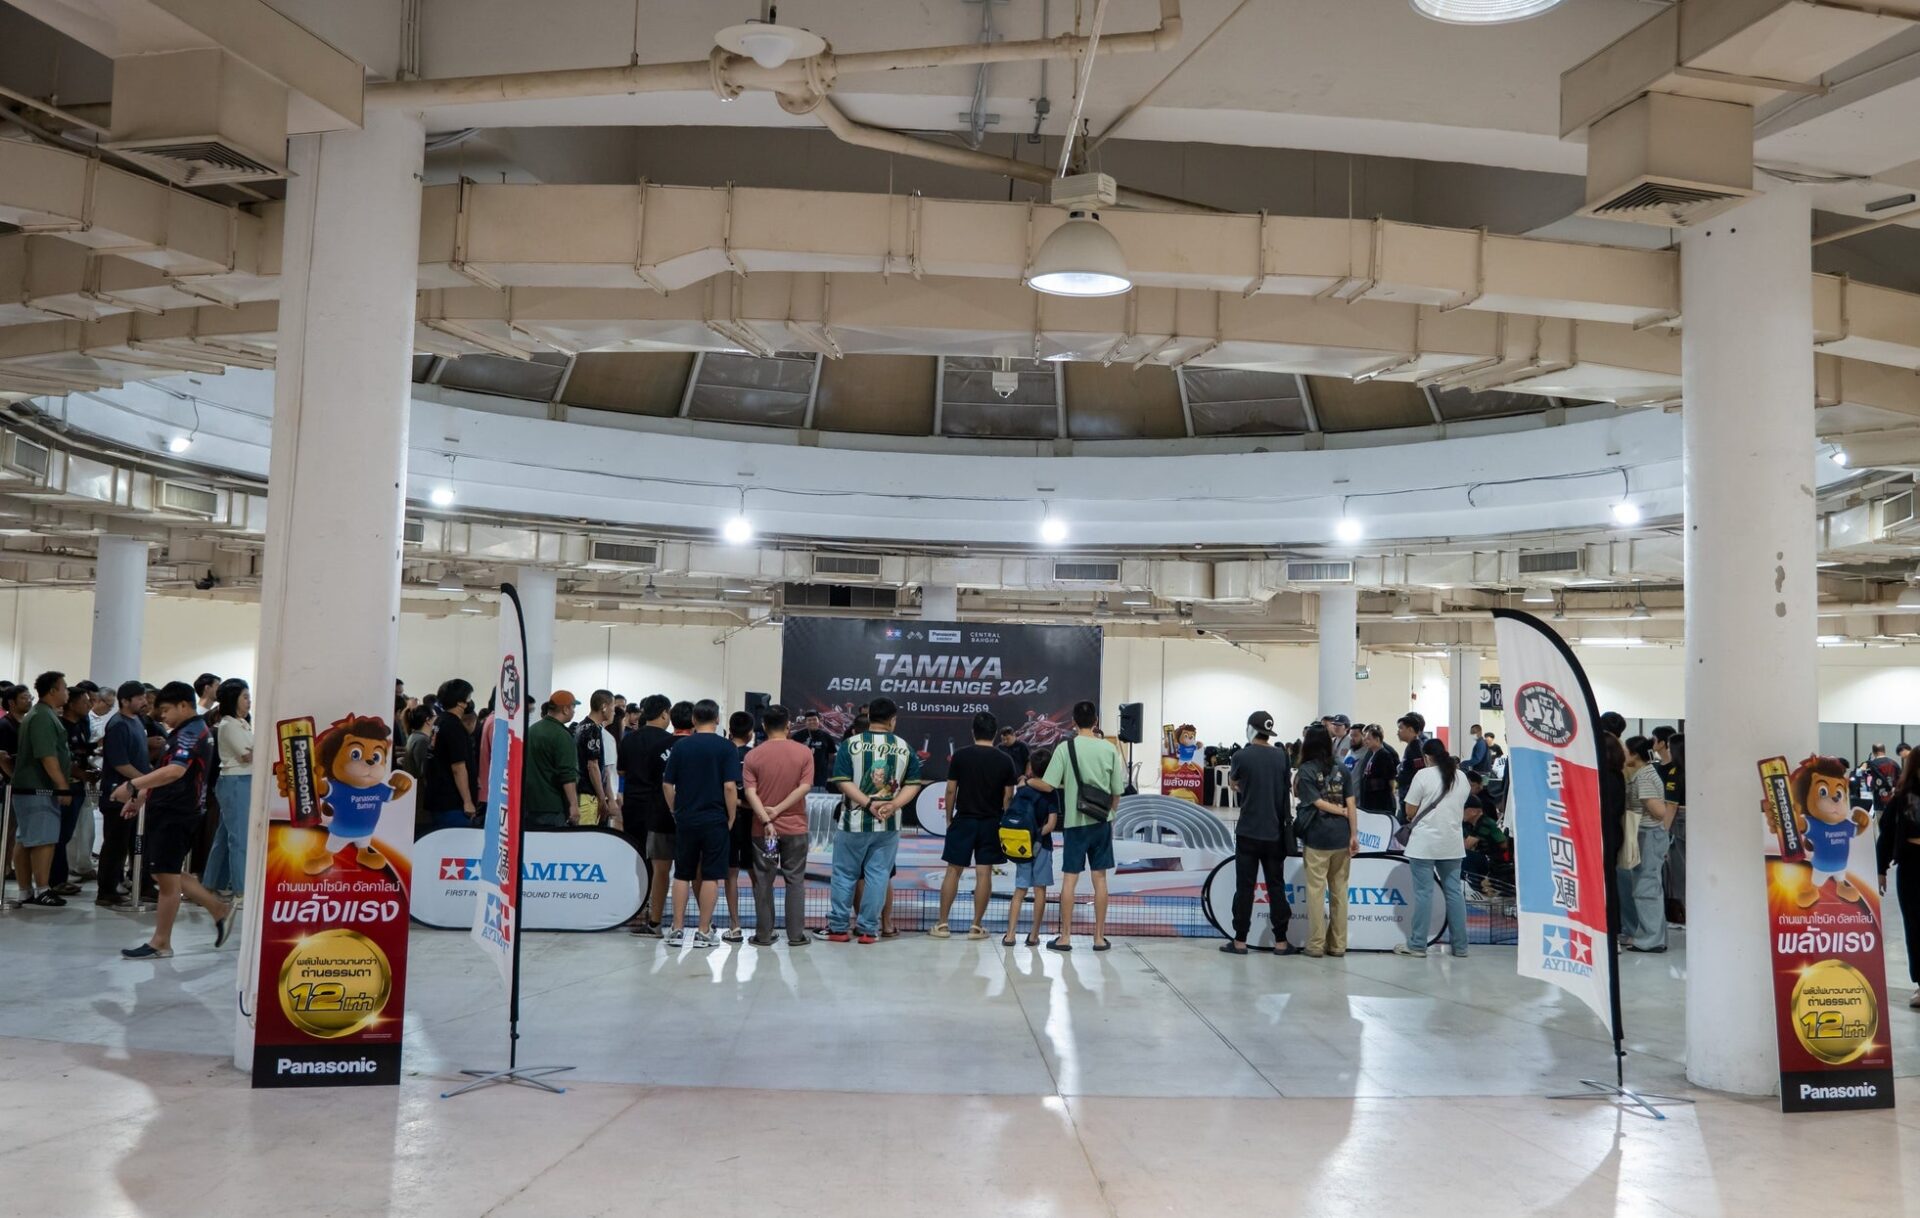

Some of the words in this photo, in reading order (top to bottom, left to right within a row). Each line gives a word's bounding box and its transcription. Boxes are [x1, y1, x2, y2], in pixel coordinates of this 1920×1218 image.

[874, 653, 1002, 679] TAMIYA
[827, 677, 872, 692] ASIA
[880, 679, 993, 695] CHALLENGE
[998, 676, 1049, 696] 2026
[906, 702, 917, 712] 18
[920, 703, 960, 712] มกราคม
[962, 703, 989, 712] 2569
[1264, 719, 1274, 730] C
[849, 740, 876, 756] One
[877, 743, 910, 758] Piece
[294, 740, 314, 815] Panasonic
[1774, 778, 1798, 850] Panasonic
[523, 862, 607, 883] MIYA
[277, 879, 350, 892] ถ่านพานาโซนิค
[353, 878, 401, 892] อัลคาไลน์
[445, 889, 468, 897] FIRST
[469, 889, 478, 897] IN
[522, 891, 550, 899] ROUND
[552, 891, 567, 899] THE
[569, 892, 600, 900] WORLD
[1297, 885, 1408, 905] TIYA
[271, 894, 400, 922] พลังแรง
[1778, 912, 1836, 925] ถ่านพานาโซนิค
[1837, 911, 1873, 924] อัลคาไลน์
[1777, 926, 1875, 954] พลังแรง
[301, 966, 371, 977] ถ่านธรรมดา
[288, 982, 345, 1011] 12
[343, 992, 374, 1011] เท่า
[1807, 996, 1861, 1006] ถ่านธรรมดา
[1800, 1010, 1844, 1039] 12
[1844, 1020, 1867, 1038] เท่า
[277, 1057, 377, 1074] Panasonic
[1800, 1082, 1877, 1099] Panasonic
